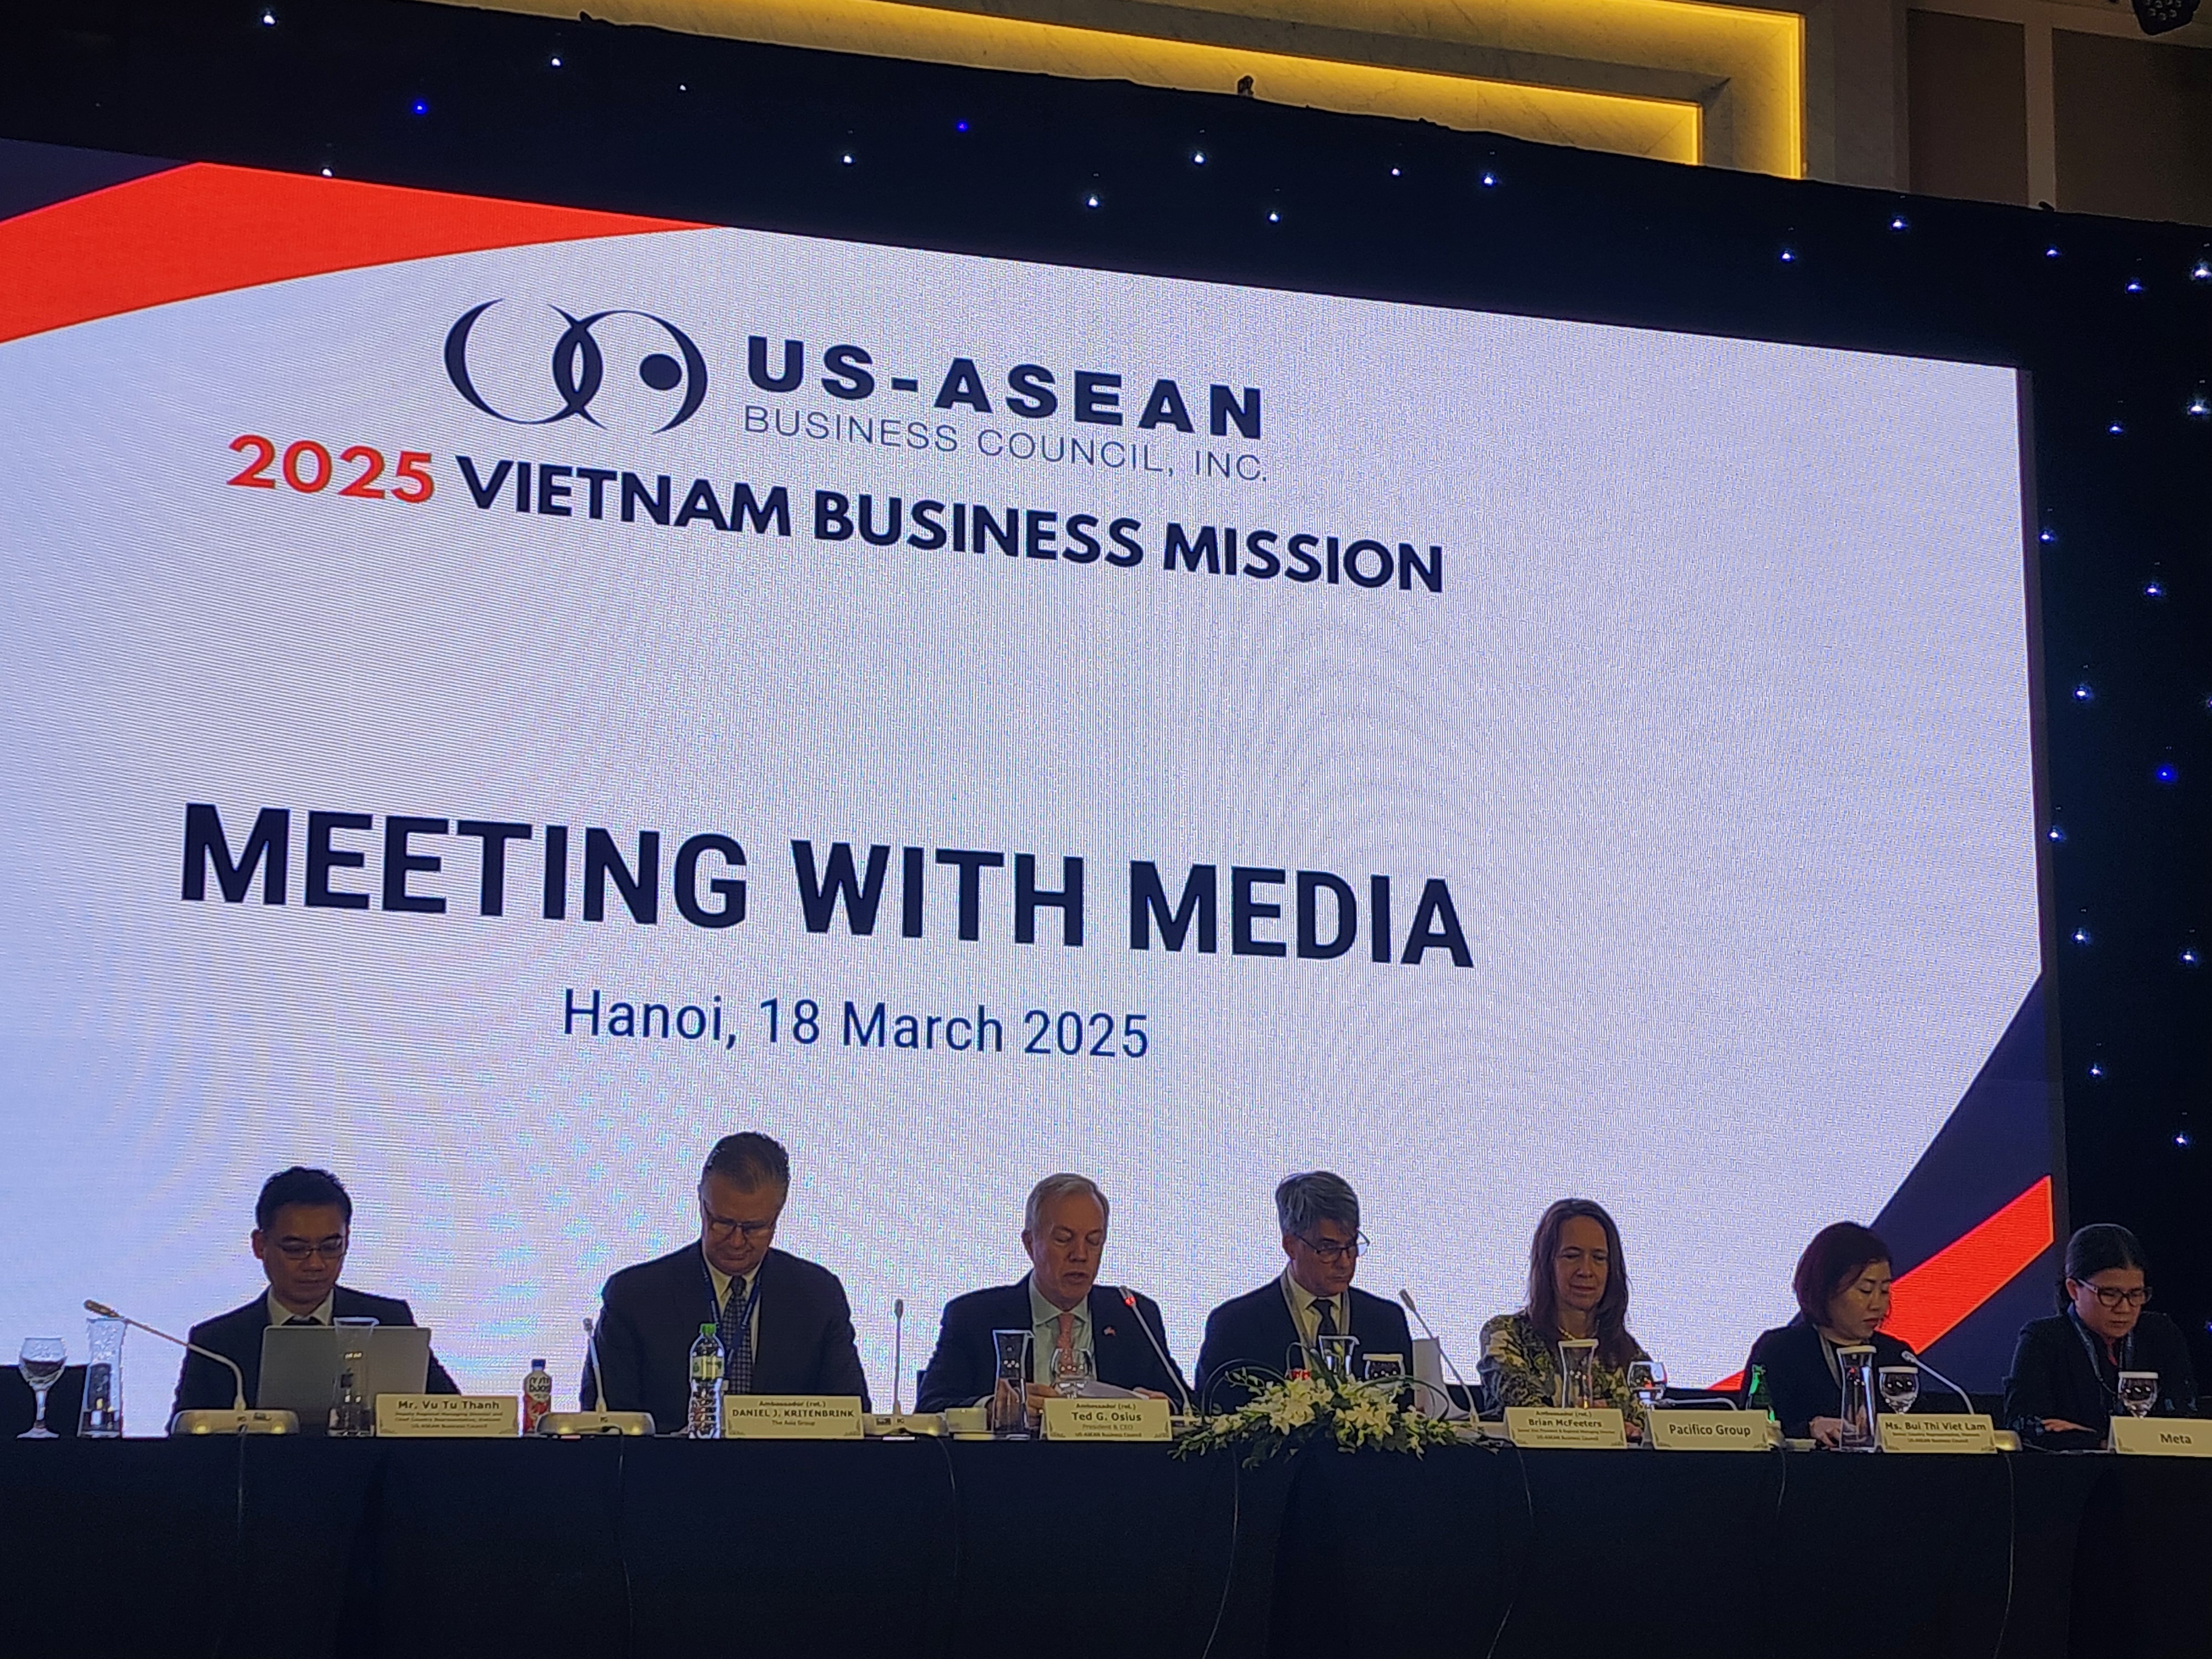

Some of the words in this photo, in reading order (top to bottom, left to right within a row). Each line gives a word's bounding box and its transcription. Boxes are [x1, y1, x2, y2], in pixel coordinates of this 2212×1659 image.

[747, 335, 1262, 440] US-ASEAN
[745, 405, 958, 452] BUSINESS
[978, 429, 1173, 476] COUNCIL,
[1195, 450, 1266, 482] INC.
[228, 435, 434, 504] 2025
[455, 455, 791, 537] VIETNAM
[814, 490, 1144, 568] BUSINESS
[1163, 523, 1443, 593] MISSION
[181, 803, 747, 929] MEETING
[791, 840, 1084, 947] WITH
[1130, 860, 1474, 968] MEDIA
[564, 988, 737, 1050] Hanoi,
[760, 998, 820, 1045] 18
[843, 1000, 1003, 1052] March
[1024, 1009, 1149, 1058] 2025
[398, 1401, 418, 1409] Mr.
[422, 1401, 438, 1409] Vu
[444, 1401, 457, 1409] Tu
[462, 1401, 499, 1409] Thanh
[1072, 1412, 1092, 1421] Ted
[1096, 1412, 1108, 1421] G.
[1112, 1412, 1142, 1421] Osius
[1556, 1419, 1602, 1427] McFeeters
[1670, 1423, 1713, 1435] Pacifico
[1716, 1425, 1751, 1437] Group
[1885, 1422, 1902, 1430] Ms.
[1905, 1422, 1921, 1430] Bui
[1925, 1422, 1939, 1431] Thi
[1942, 1422, 1963, 1431] Viet
[2160, 1433, 2192, 1444] Meta
